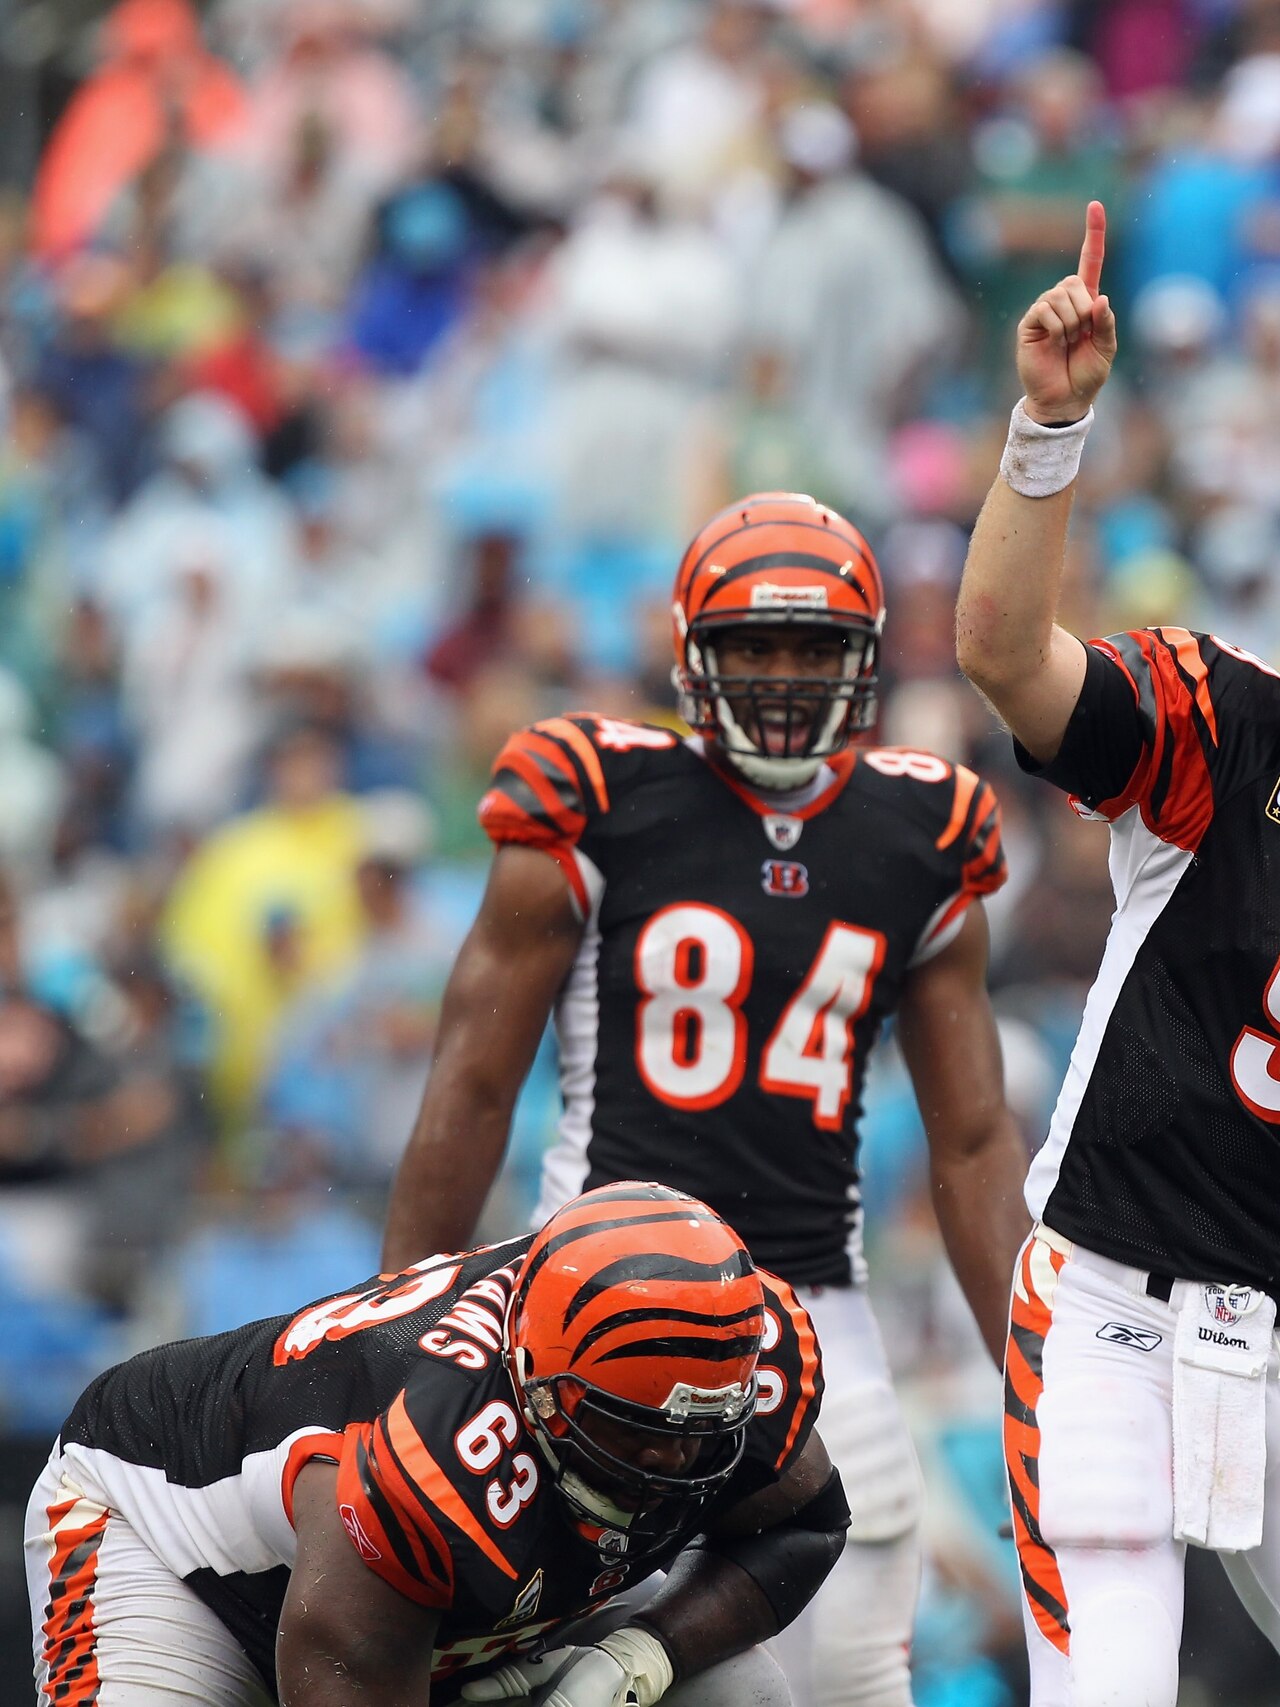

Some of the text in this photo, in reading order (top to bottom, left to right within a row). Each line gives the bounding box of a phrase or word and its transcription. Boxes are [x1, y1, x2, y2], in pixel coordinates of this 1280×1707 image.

[634, 900, 888, 1132] 84
[1198, 1326, 1249, 1351] Wilson
[453, 1399, 539, 1530] 63
